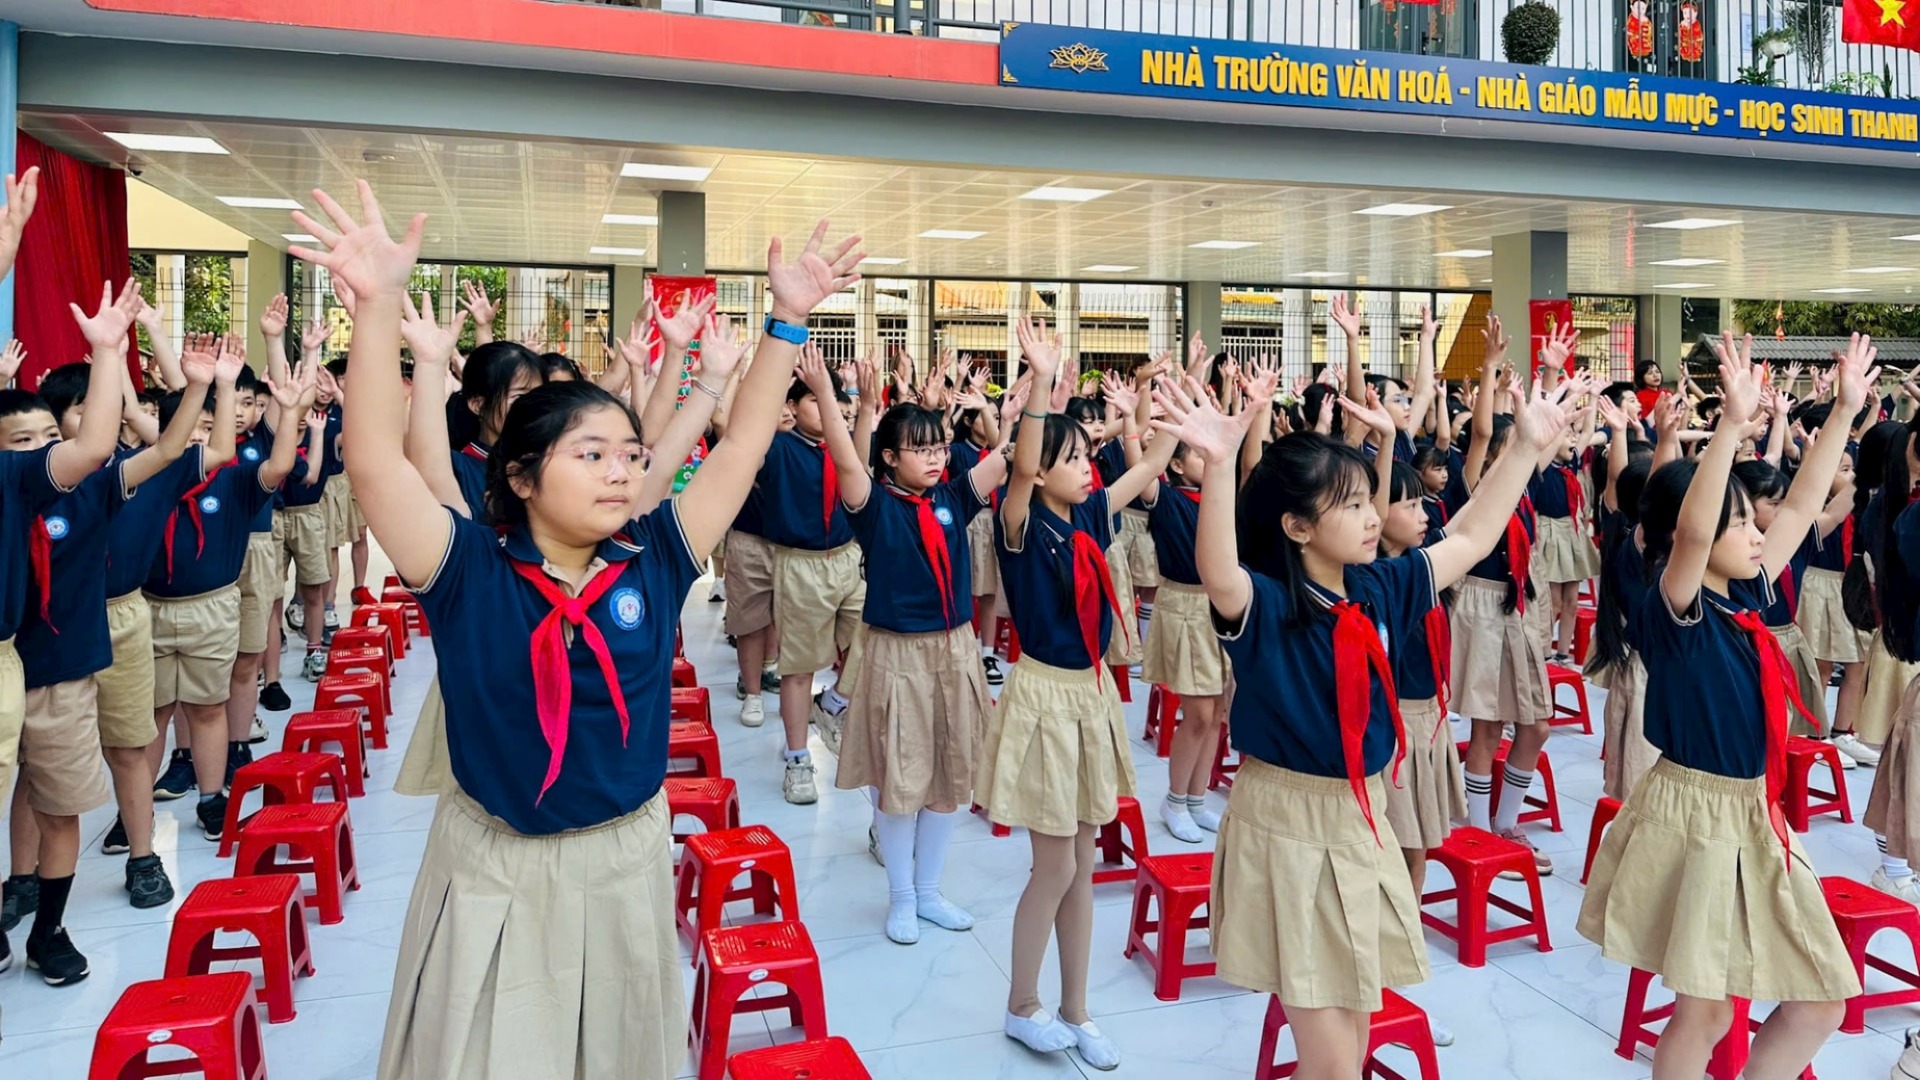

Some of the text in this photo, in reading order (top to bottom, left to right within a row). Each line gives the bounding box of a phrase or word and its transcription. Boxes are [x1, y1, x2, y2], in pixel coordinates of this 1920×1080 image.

[1141, 46, 1204, 88] NHÀ
[1213, 52, 1328, 97] TRƯỜNG
[1336, 59, 1390, 101] VĂN
[1398, 65, 1453, 105] HOÁ
[1459, 86, 1471, 95] -
[1477, 72, 1531, 111] NHÀ
[1539, 76, 1596, 116] GIÁO
[1604, 78, 1658, 121] MẪU
[1665, 92, 1718, 131] MỰC
[1740, 99, 1785, 137] HỌC
[1791, 103, 1844, 136] SINH
[1848, 108, 1919, 142] THANH
